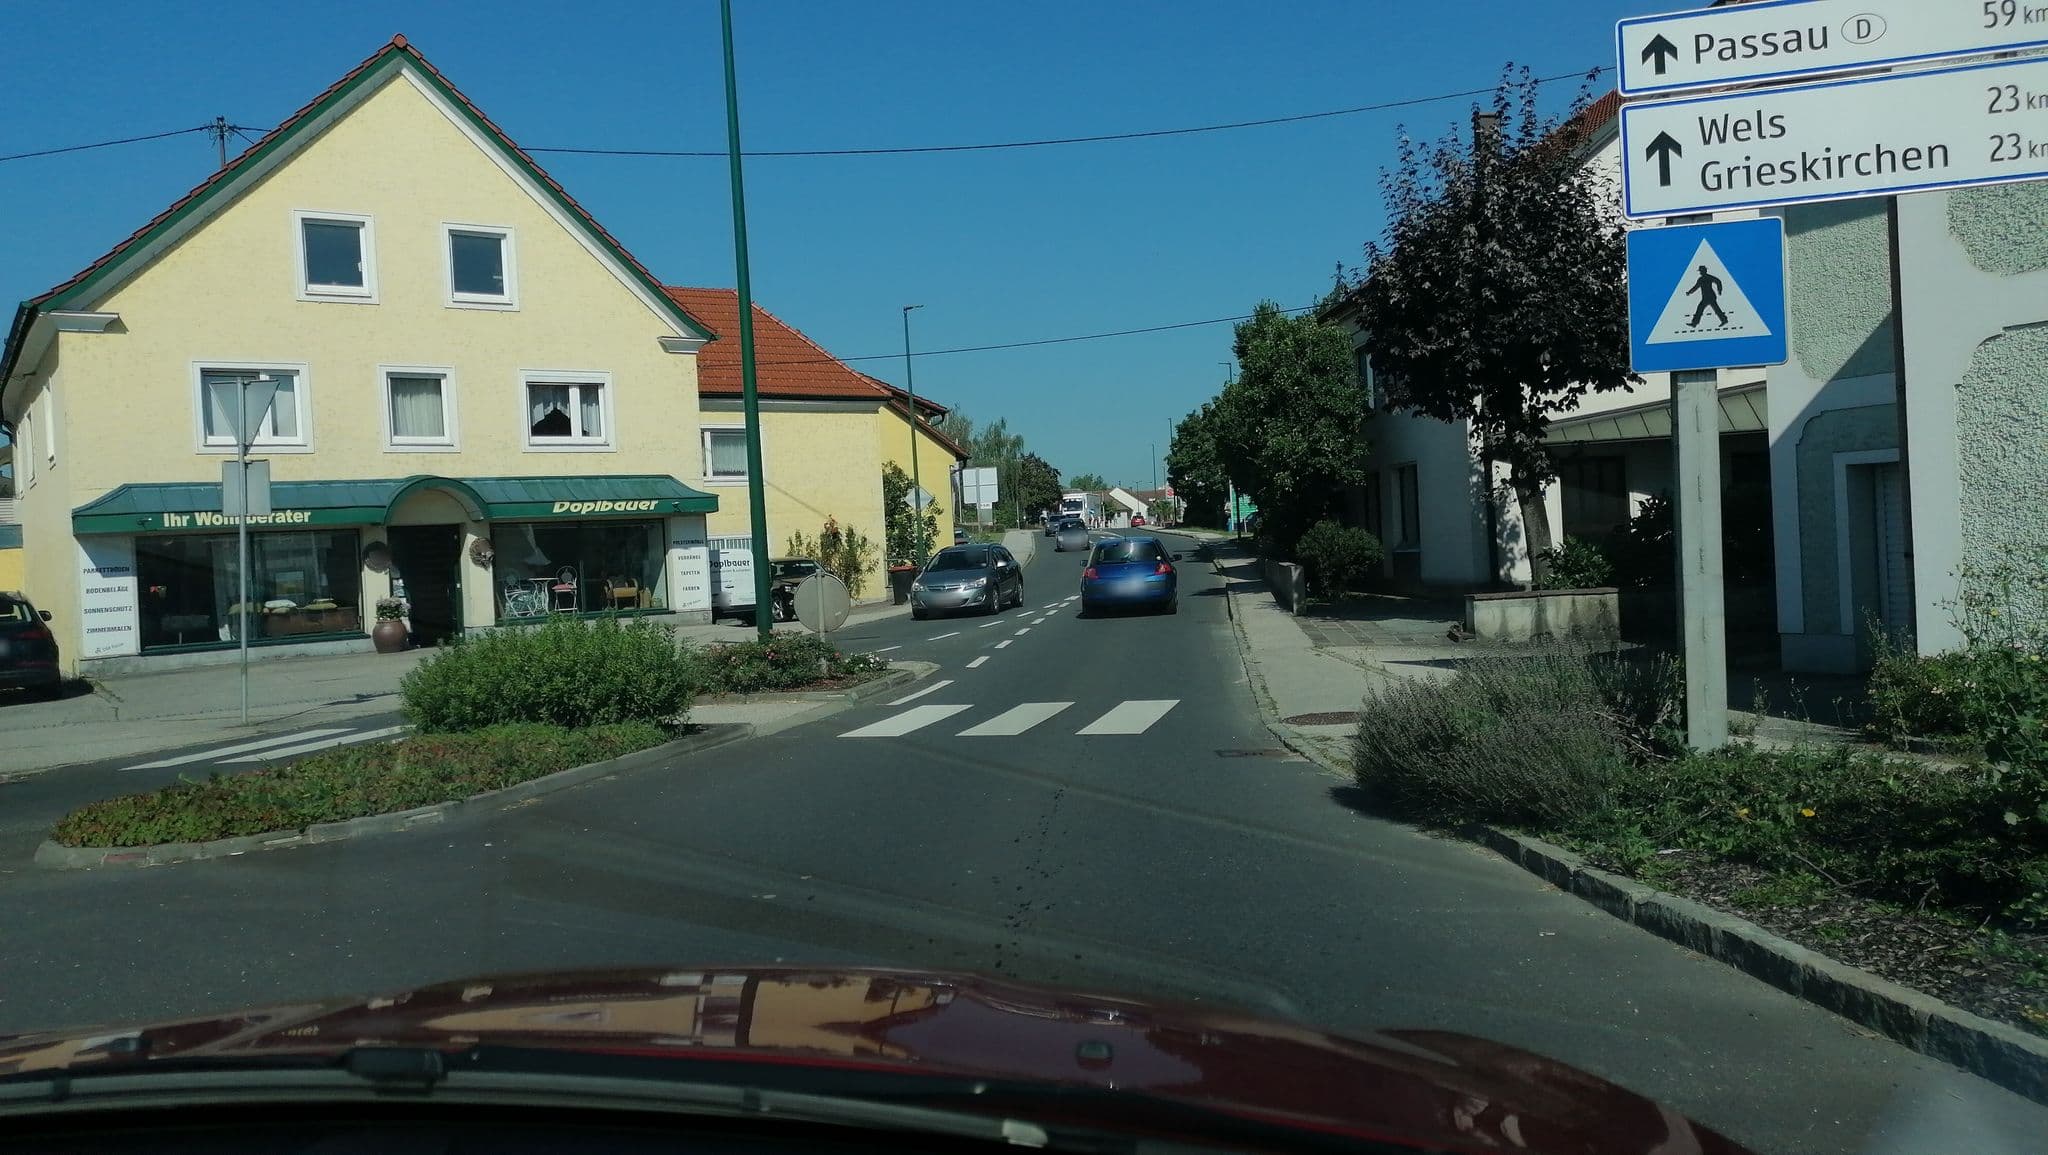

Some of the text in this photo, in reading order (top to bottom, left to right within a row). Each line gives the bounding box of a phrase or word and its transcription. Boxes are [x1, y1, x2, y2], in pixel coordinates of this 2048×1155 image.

[1694, 25, 1828, 64] Passau
[1856, 18, 1872, 40] D
[1983, 0, 2016, 29] 59
[1698, 109, 1787, 146] Wels
[1987, 84, 2020, 114] 23
[1700, 143, 1949, 192] Grieskirchen
[1989, 132, 2022, 163] 23
[163, 512, 190, 527] Ihr
[552, 499, 659, 515] Doplbauer
[83, 605, 133, 615] SONNENSCHUTZ
